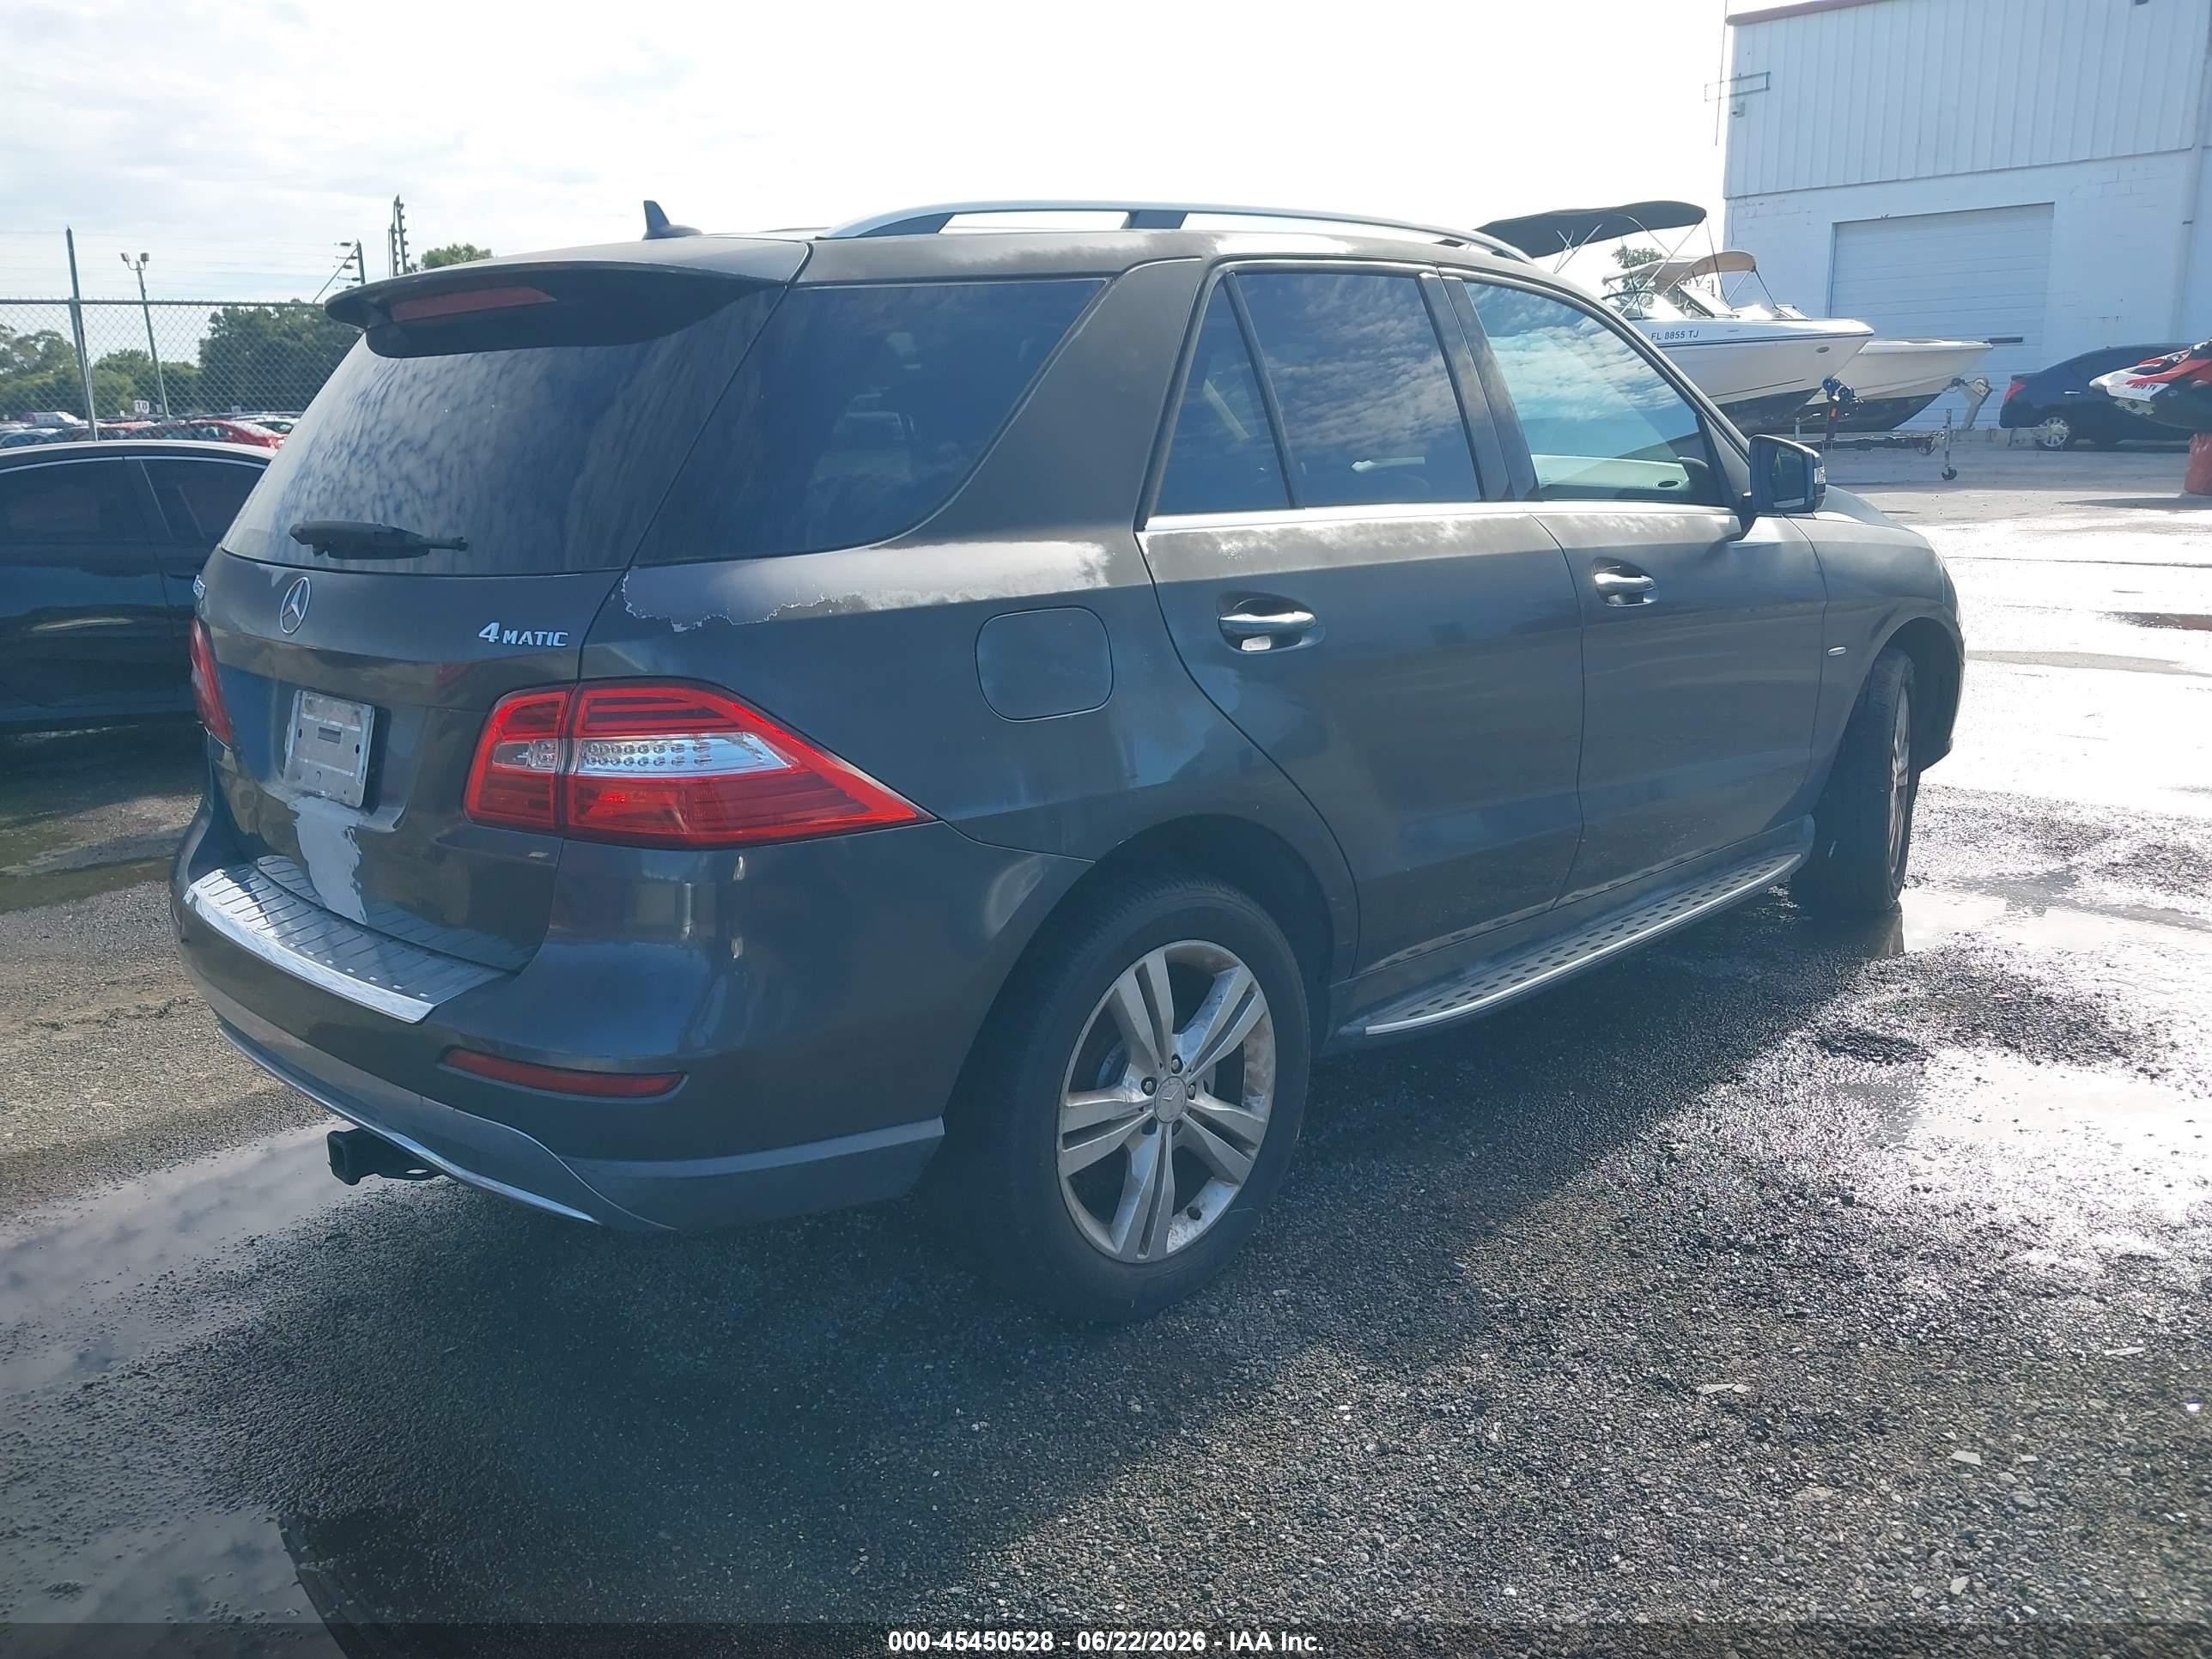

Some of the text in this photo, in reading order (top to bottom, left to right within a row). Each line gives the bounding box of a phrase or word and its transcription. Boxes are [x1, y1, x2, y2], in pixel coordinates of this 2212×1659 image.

[1651, 332, 1662, 341] FL
[1688, 330, 1699, 338] TJ
[478, 622, 568, 647] 4MATIC
